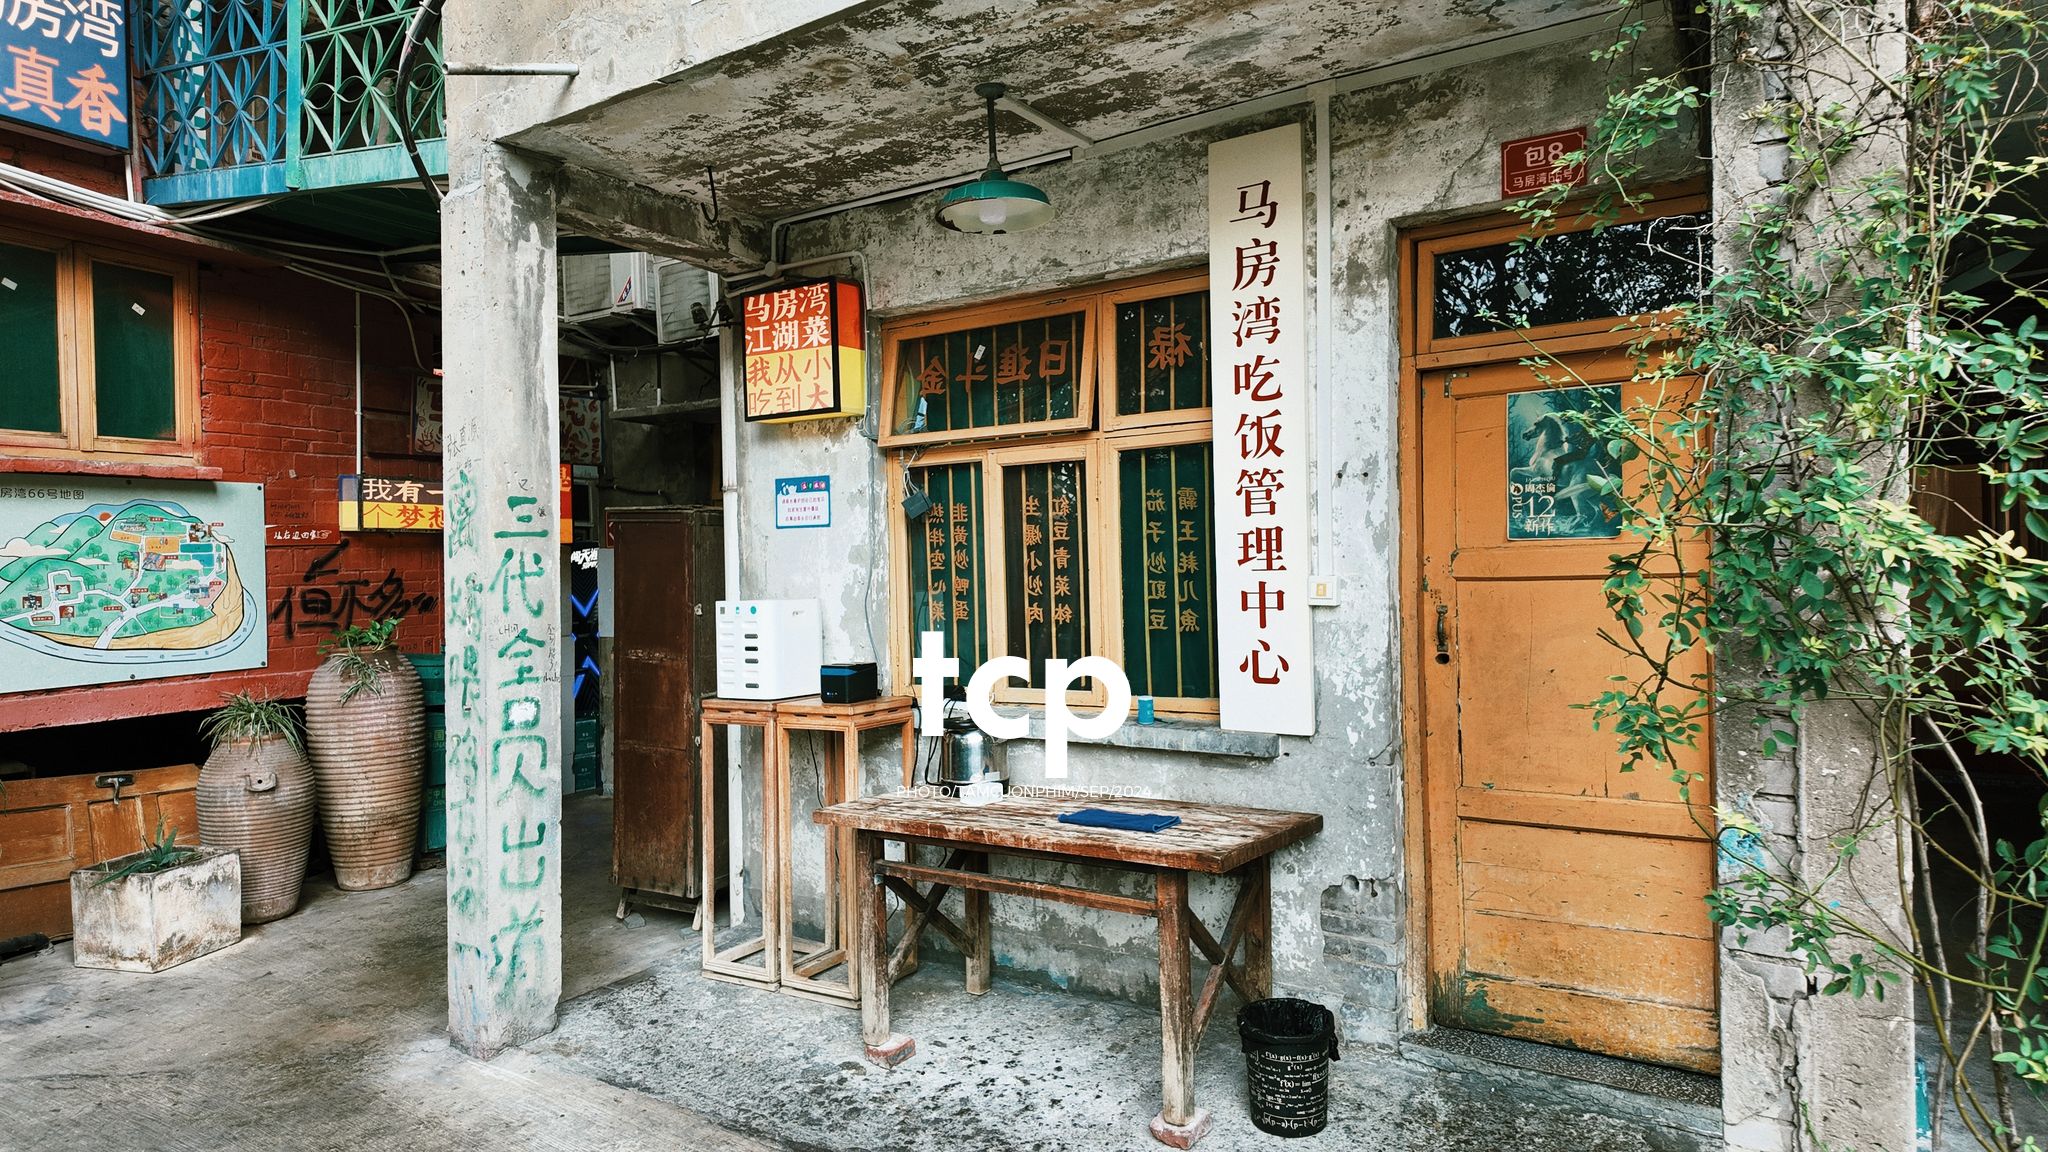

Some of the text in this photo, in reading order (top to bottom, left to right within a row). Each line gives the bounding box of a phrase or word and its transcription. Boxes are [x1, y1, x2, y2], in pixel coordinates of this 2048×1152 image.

[1524, 141, 1564, 168] 包8
[745, 283, 829, 323] 马房湾
[746, 315, 831, 355] 江湖菜
[747, 349, 832, 388] 我从小
[748, 383, 829, 416] 吃到大
[1229, 179, 1289, 686] 马房湾吃饭管理中心
[363, 478, 444, 504] 我有一
[1521, 495, 1556, 518] 12
[1523, 516, 1557, 537] 新作
